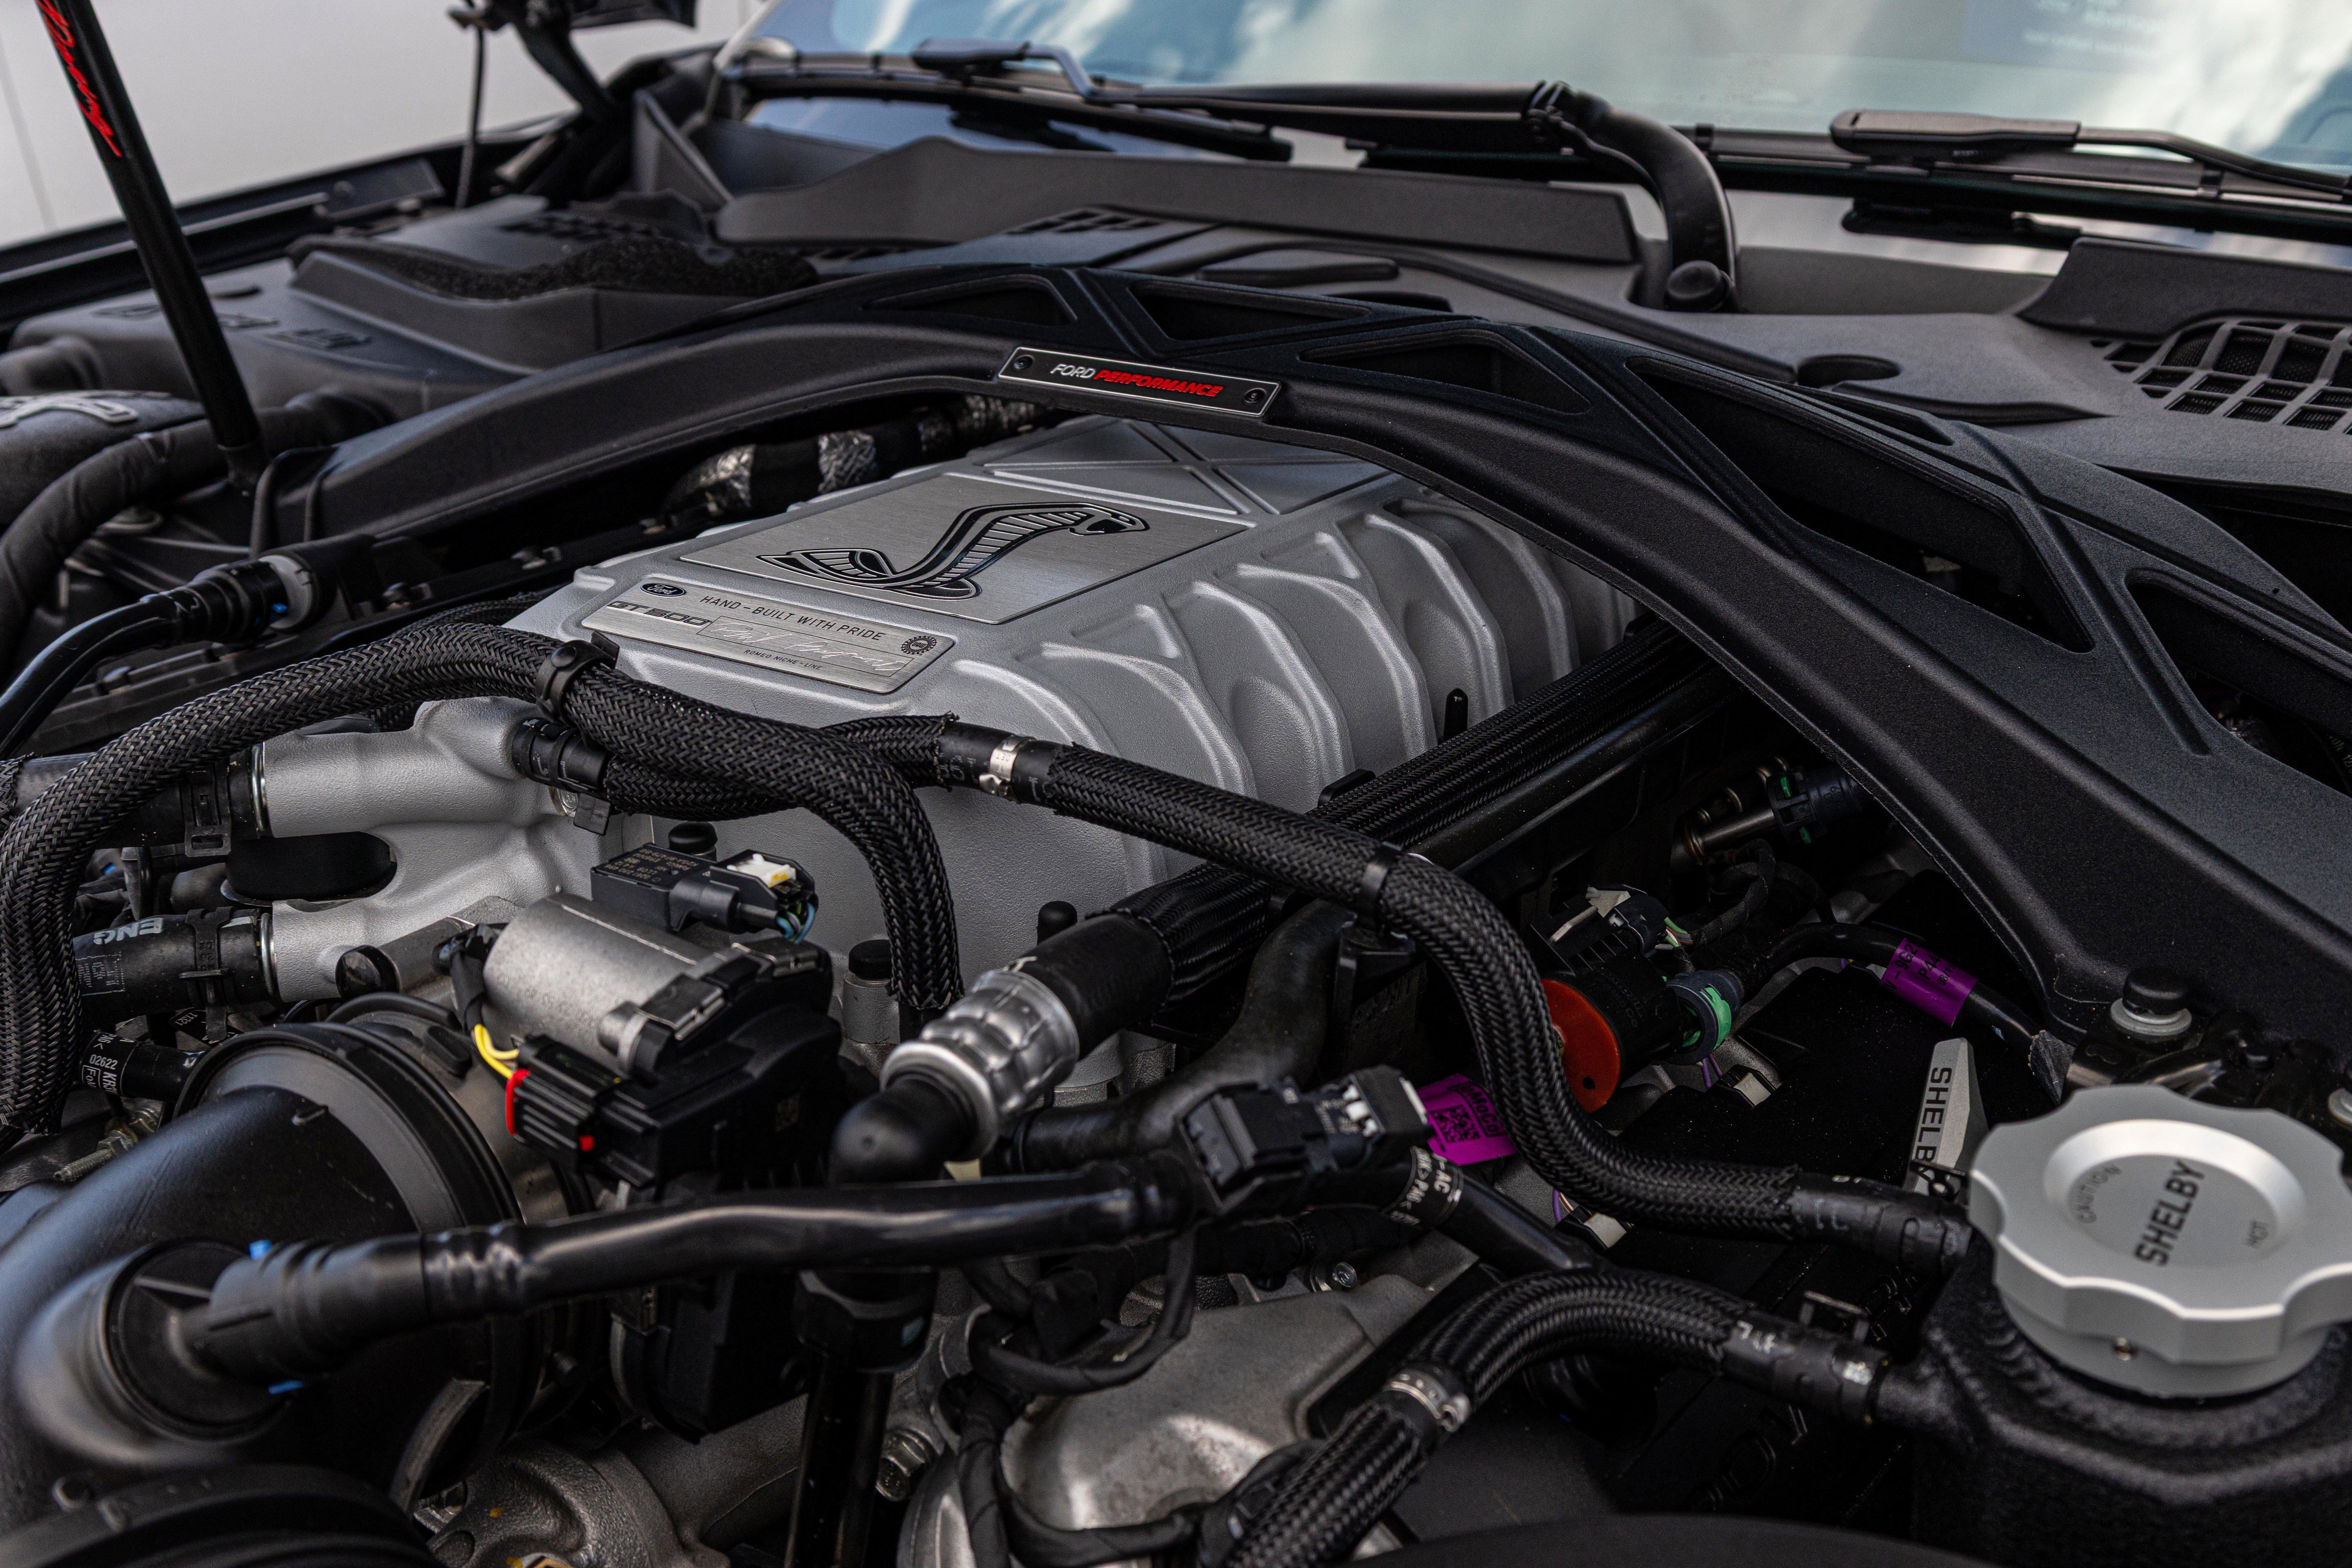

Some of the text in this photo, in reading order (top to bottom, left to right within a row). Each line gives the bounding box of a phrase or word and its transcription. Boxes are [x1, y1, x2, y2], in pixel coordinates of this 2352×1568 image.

[1050, 363, 1224, 397] FORD PERFORMANCE
[797, 614, 836, 632] WITH
[837, 621, 886, 641] PRIDE
[744, 649, 771, 659] ROMEO
[93, 917, 165, 945] ENG
[89, 1054, 118, 1070] 02622
[2076, 1163, 2122, 1223] CAUTION
[2134, 1160, 2205, 1266] SHELBY
